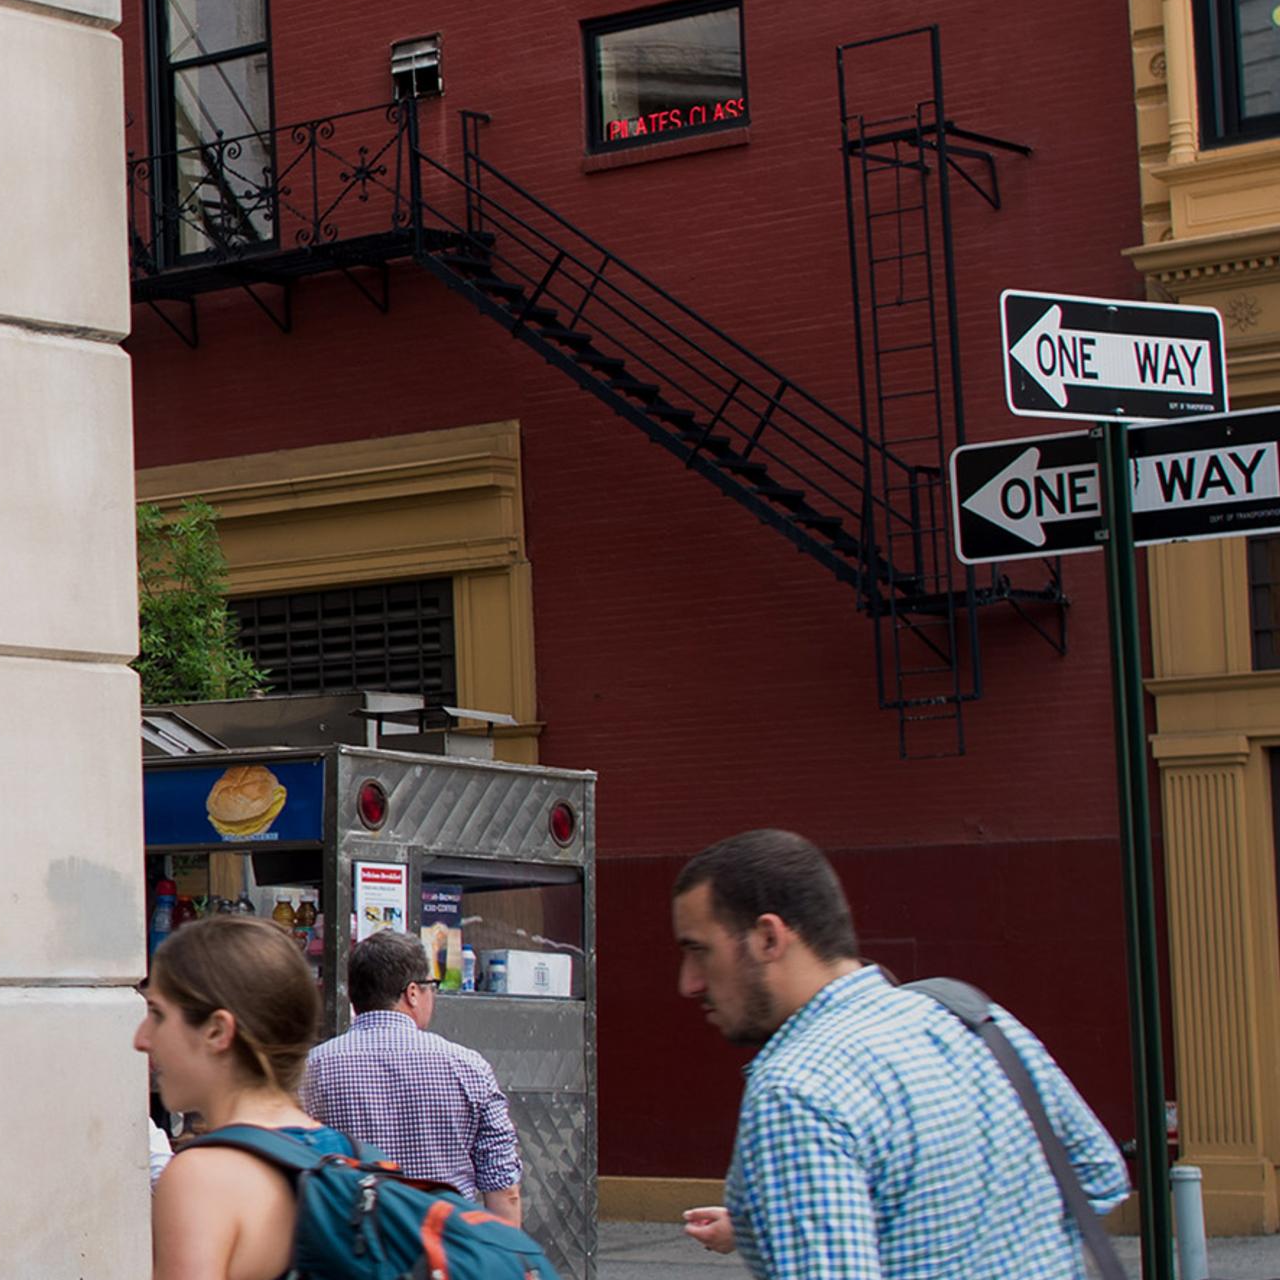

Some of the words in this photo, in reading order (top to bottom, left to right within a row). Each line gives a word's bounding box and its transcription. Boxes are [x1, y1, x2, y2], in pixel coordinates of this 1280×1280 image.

[609, 108, 682, 141] PILATES
[1036, 333, 1099, 380] ONE
[1134, 341, 1203, 386] WAY
[1000, 469, 1099, 520] ONE
[1155, 448, 1267, 503] WAY
